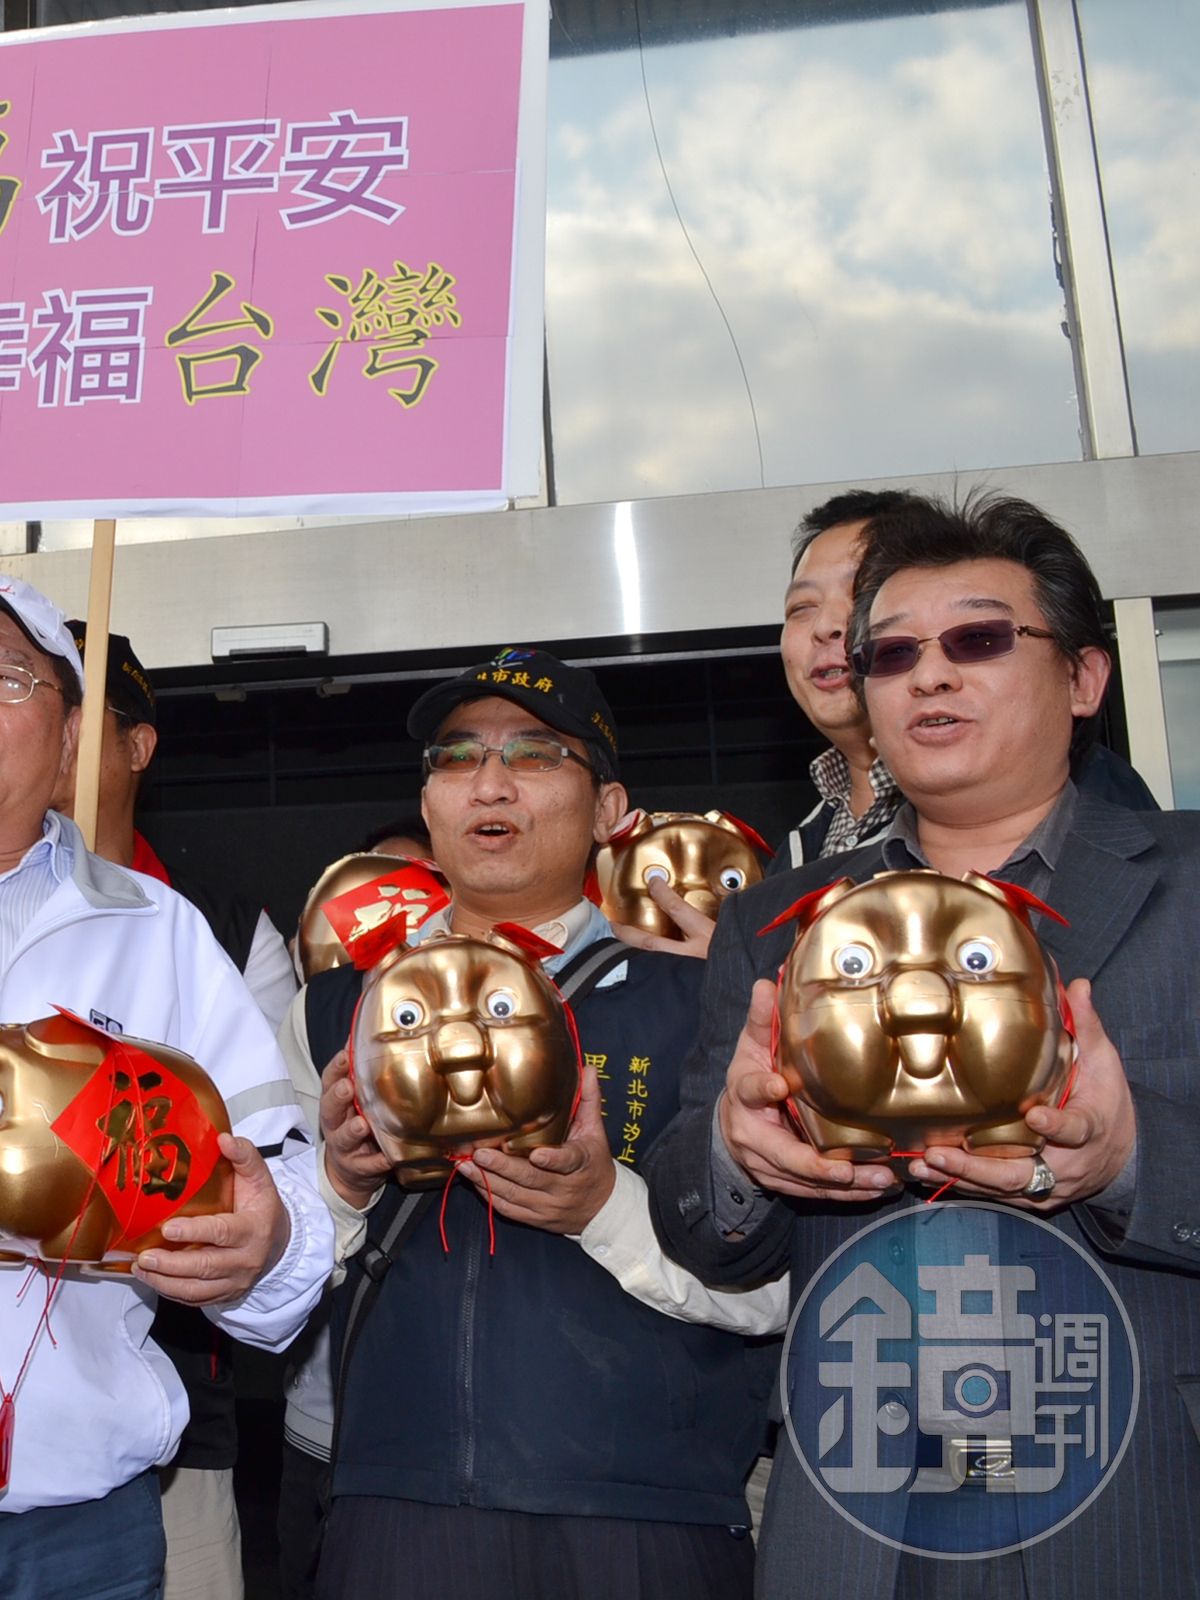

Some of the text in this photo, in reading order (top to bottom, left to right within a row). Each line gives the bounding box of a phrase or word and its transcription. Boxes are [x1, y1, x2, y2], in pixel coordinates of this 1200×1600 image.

[96, 1071, 192, 1201] 福
[617, 1055, 651, 1164] 新北市汐止
